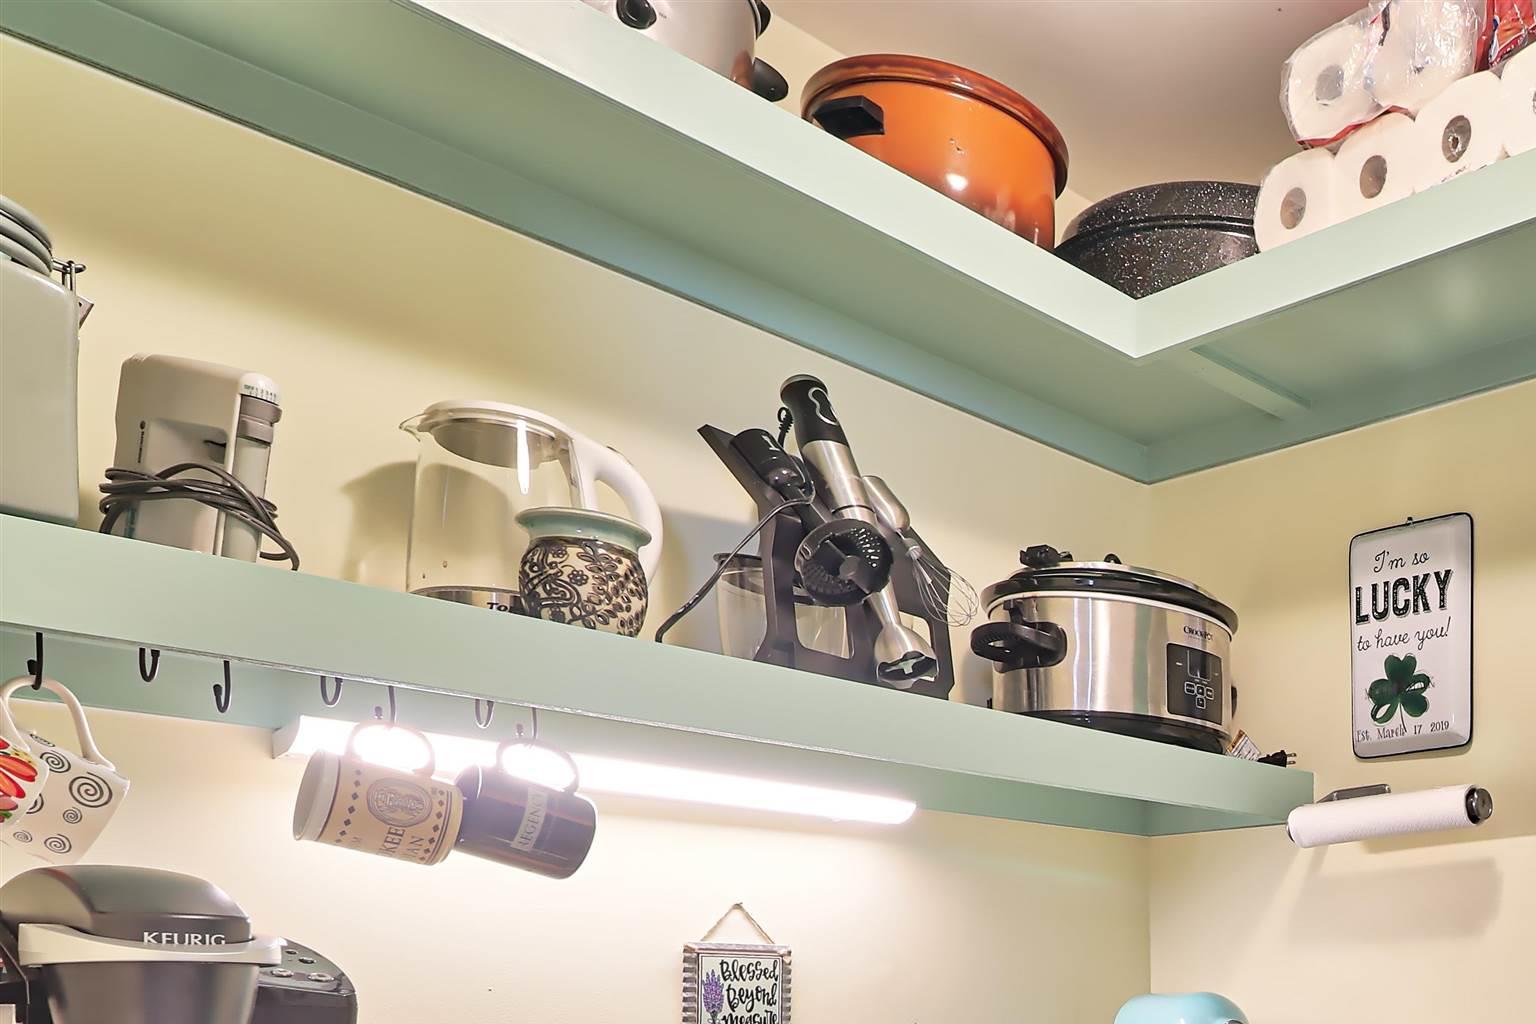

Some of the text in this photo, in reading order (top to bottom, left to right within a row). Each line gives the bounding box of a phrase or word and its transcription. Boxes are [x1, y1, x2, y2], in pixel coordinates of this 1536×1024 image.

[1373, 549, 1430, 573] I'm so
[1355, 568, 1454, 626] LUCKY
[1357, 616, 1452, 652] to have you!
[1413, 724, 1423, 735] 17
[1430, 720, 1450, 733] 2019
[143, 930, 227, 947] KEURIG
[720, 959, 779, 982] Blessed
[726, 983, 777, 1013] Beyond
